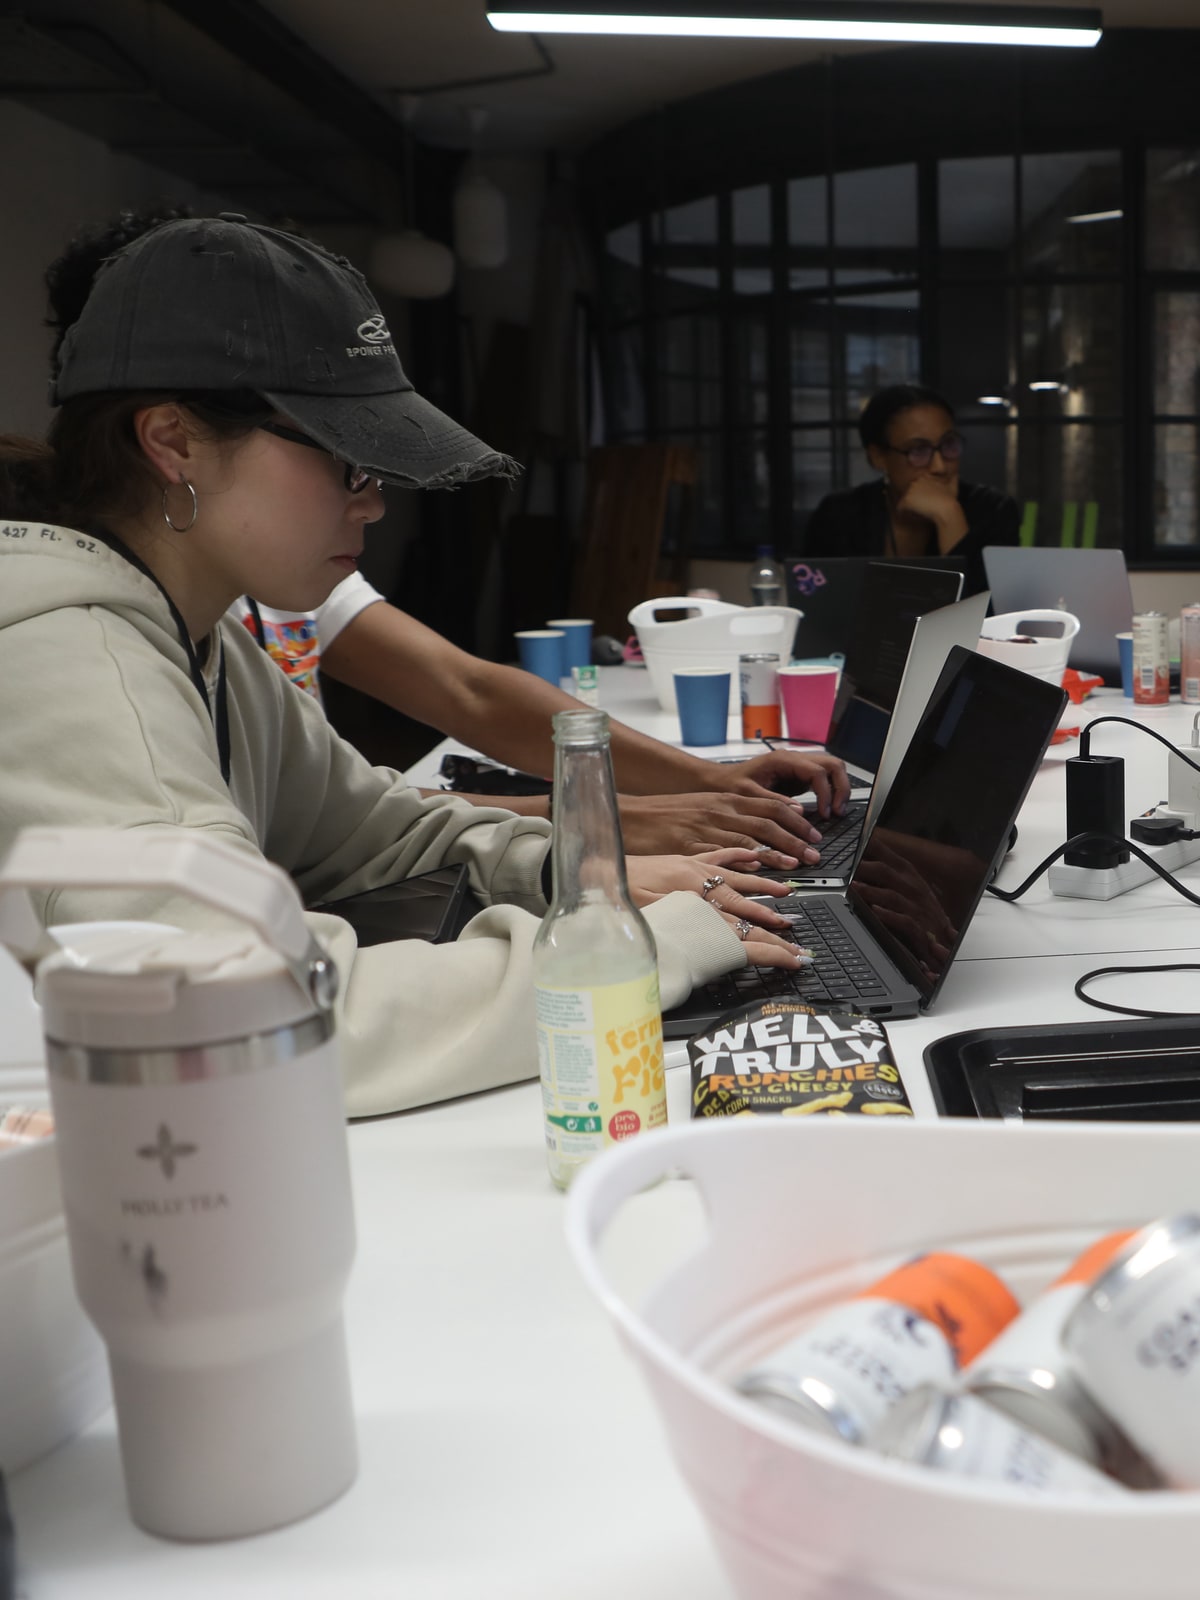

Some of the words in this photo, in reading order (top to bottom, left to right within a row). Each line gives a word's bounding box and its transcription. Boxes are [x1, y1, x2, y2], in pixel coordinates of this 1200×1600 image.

[2, 526, 28, 538] 427
[40, 528, 62, 541] FL.
[76, 539, 100, 554] OZ.
[694, 1014, 861, 1053] WELL
[851, 1019, 885, 1037] &
[693, 1039, 887, 1080] TRULY
[693, 1064, 899, 1107] CRUNCHIES
[767, 1082, 853, 1094] CHEESY
[725, 1097, 750, 1116] CORN
[752, 1095, 792, 1104] SNACKS
[614, 1113, 636, 1124] pro
[615, 1122, 635, 1132] bio
